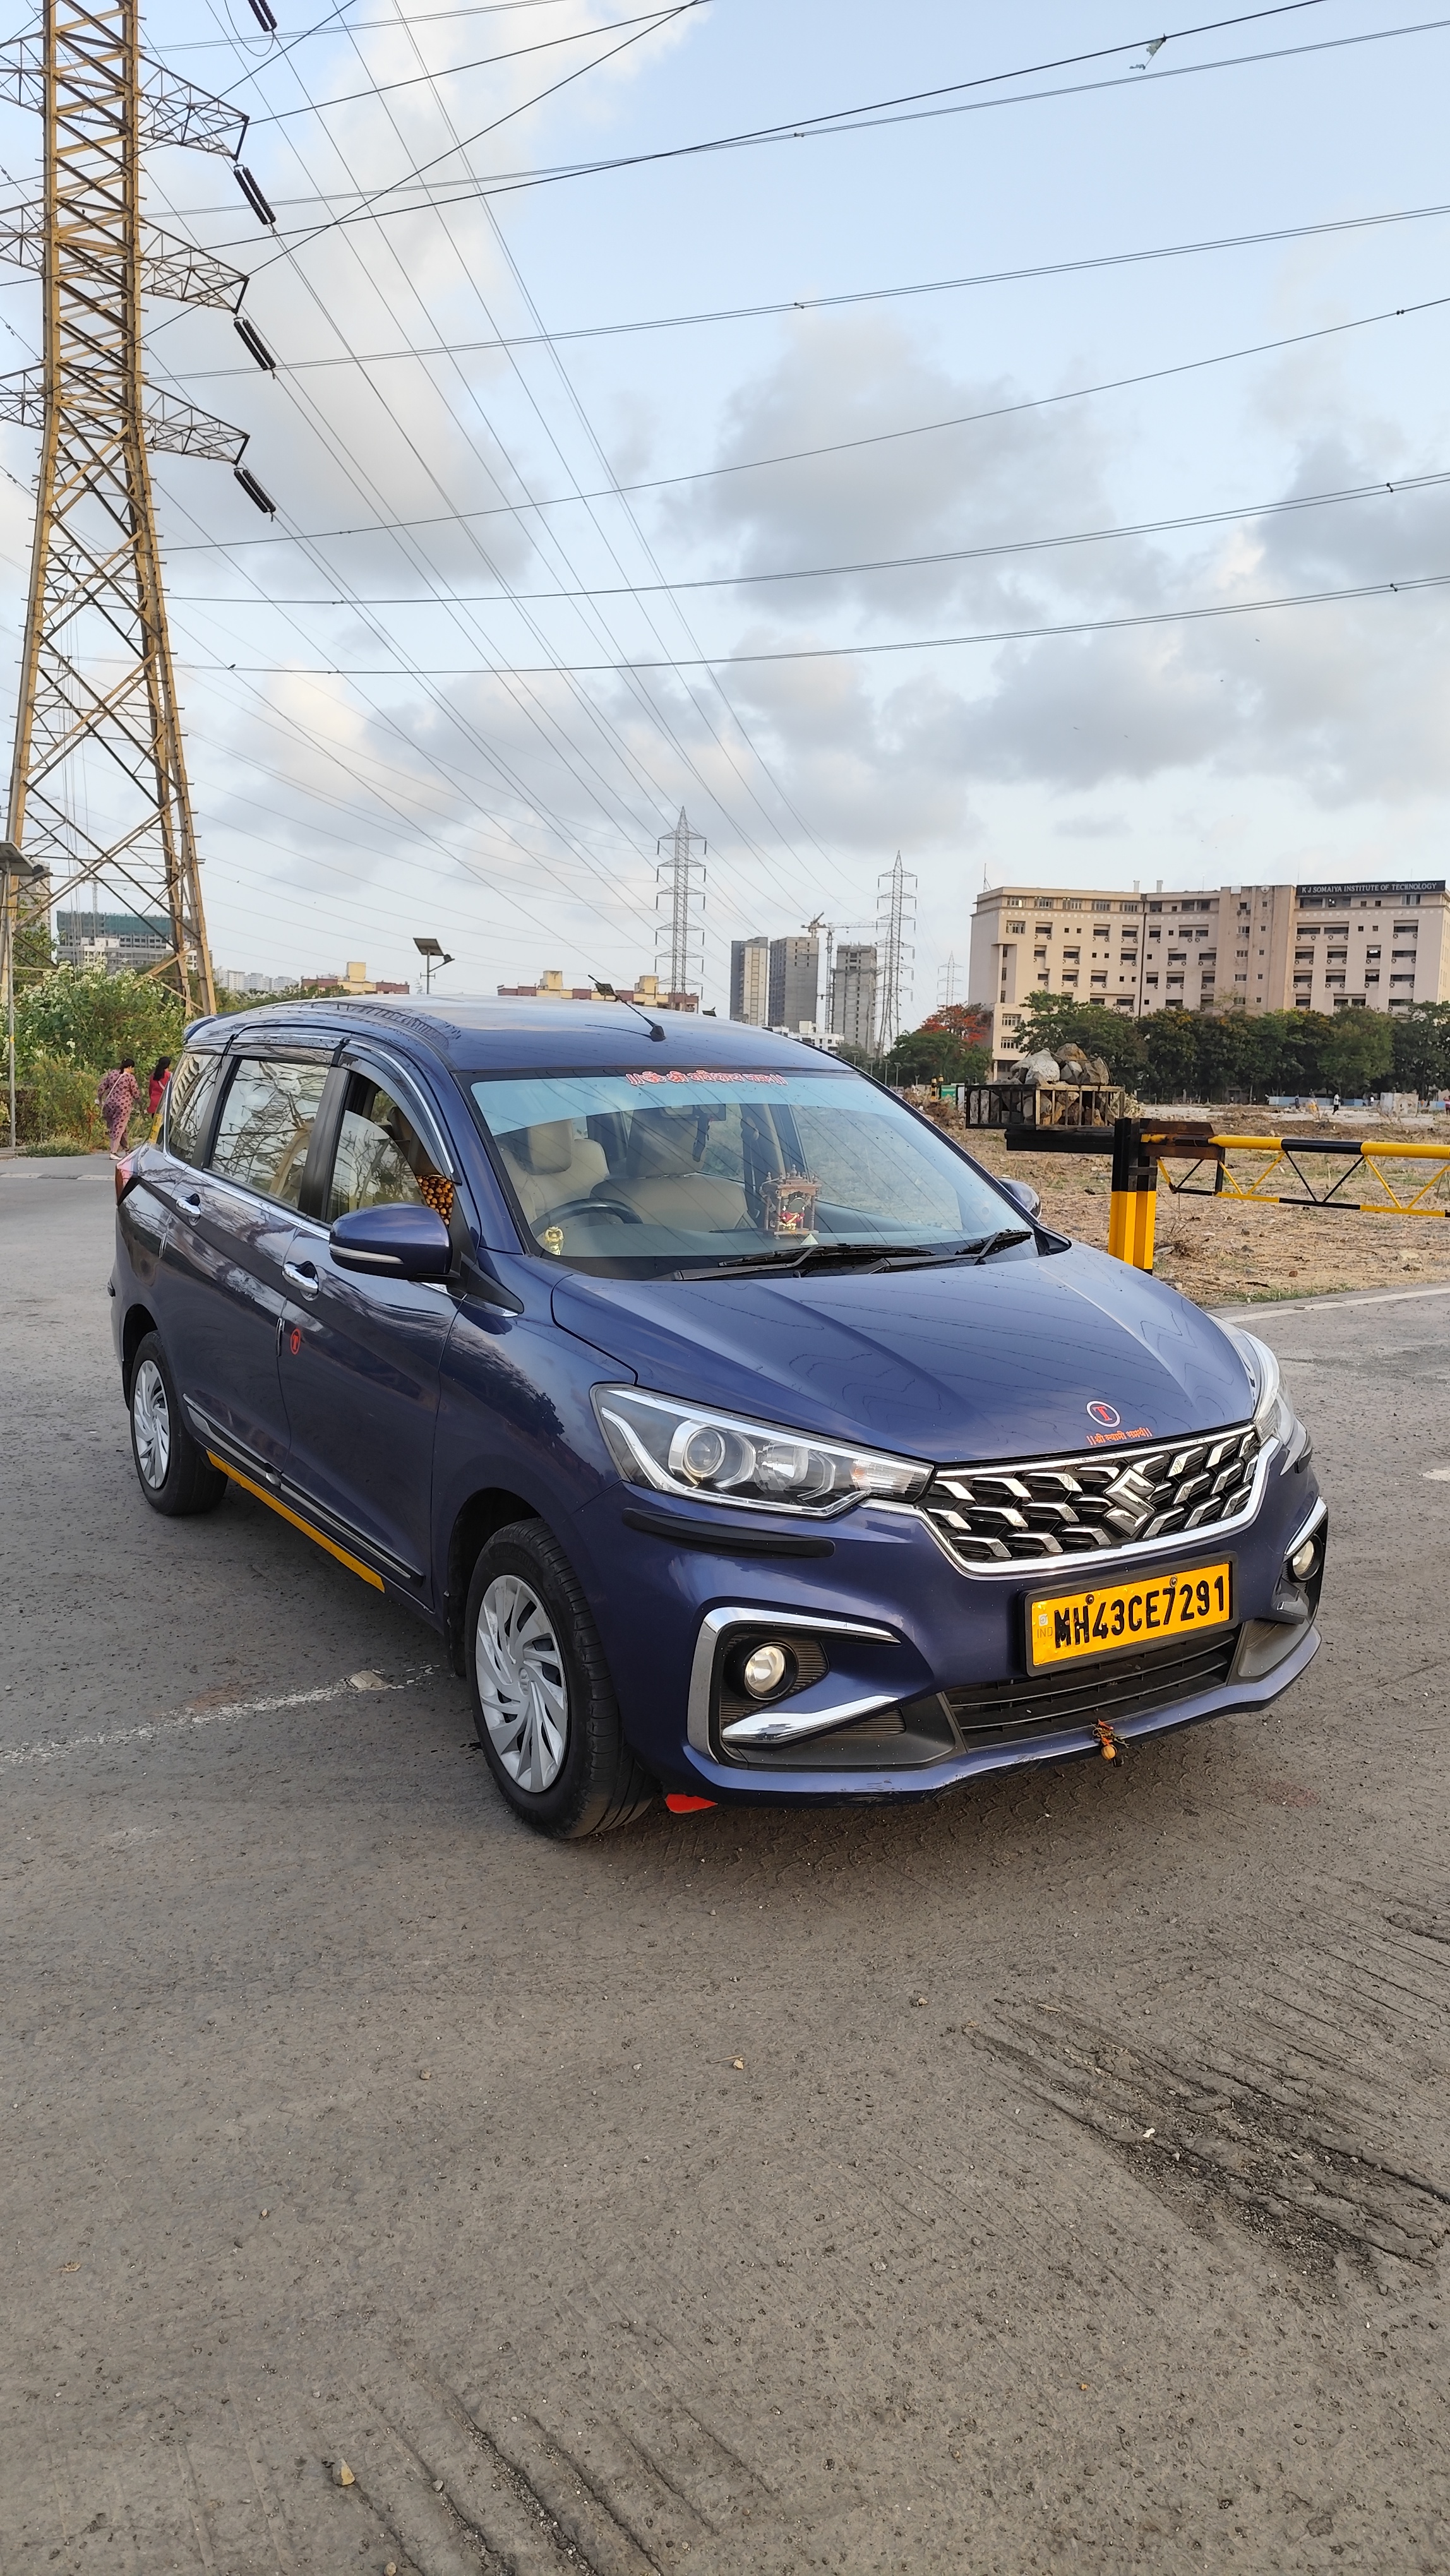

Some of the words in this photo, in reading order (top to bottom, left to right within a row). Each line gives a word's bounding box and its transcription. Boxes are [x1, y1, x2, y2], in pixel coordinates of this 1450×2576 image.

[1344, 884, 1379, 892] INSTITUTE
[1391, 883, 1437, 891] TECHNOLOGY
[1091, 1405, 1113, 1422] T
[1054, 1575, 1224, 1649] MH43CE7291
[1037, 1626, 1053, 1639] IND
